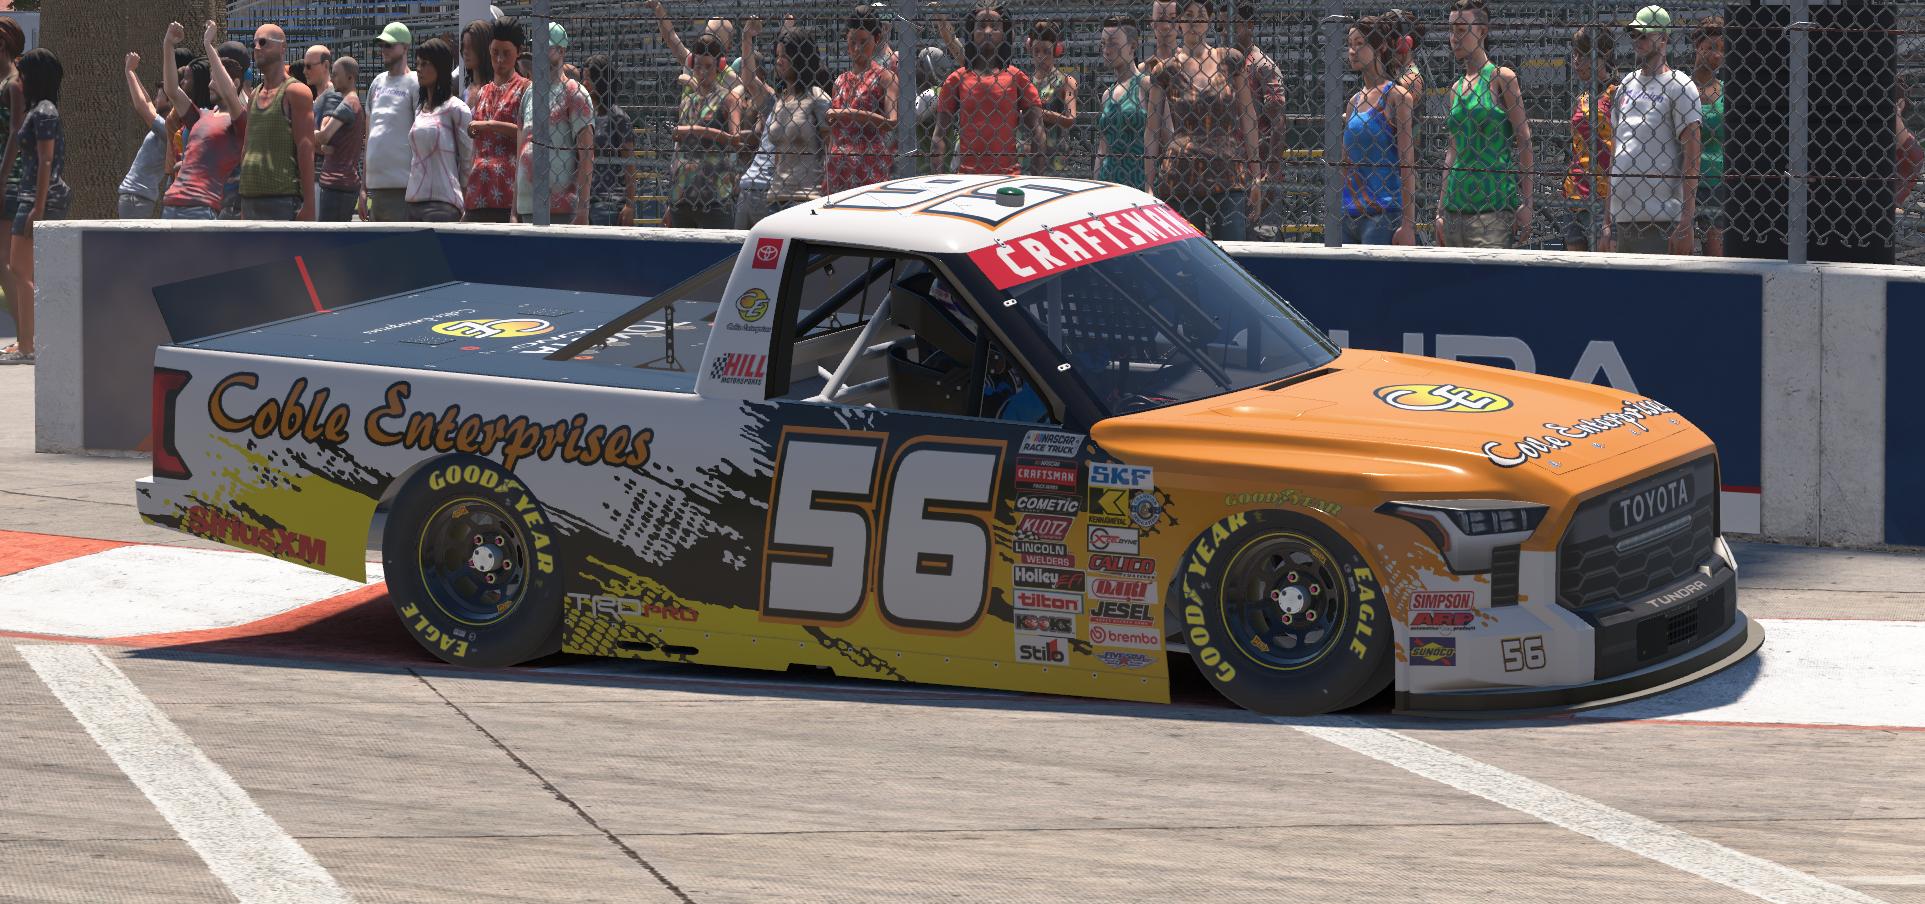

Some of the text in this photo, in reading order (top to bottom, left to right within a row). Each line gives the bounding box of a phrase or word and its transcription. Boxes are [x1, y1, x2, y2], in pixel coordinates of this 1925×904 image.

[997, 205, 1194, 278] CRAFTSMAN
[722, 353, 767, 378] HILL
[208, 371, 654, 472] Coble Enterprises
[1023, 443, 1074, 454] RACE TRUCK
[1040, 432, 1076, 446] NASCAR
[1017, 468, 1074, 483] CRAFTSMAN
[1090, 465, 1150, 486] SKF
[1016, 496, 1079, 512] COMETIC
[1619, 477, 1689, 528] TOYOTA
[757, 424, 1009, 638] 56
[1022, 518, 1068, 536] KLOTZ
[1088, 516, 1128, 526] KENNAMETAL
[1015, 542, 1066, 556] LINCOLN
[1026, 555, 1070, 567] WELDERS
[1089, 555, 1155, 575] CALICO
[1015, 567, 1059, 589] Holley
[1018, 591, 1078, 611] tilton
[1412, 592, 1471, 610] SIMPSON
[1645, 579, 1708, 609] TUNDRA
[567, 592, 699, 623] TRD PRO
[1090, 600, 1154, 621] JESEL
[1350, 567, 1375, 661] EAGLE
[1409, 612, 1475, 626] ARP
[400, 602, 470, 659] EAGLE
[1109, 631, 1158, 646] brembo
[1020, 639, 1064, 663] Stilo
[1411, 646, 1457, 658] SUNOCO
[1501, 634, 1546, 673] 56
